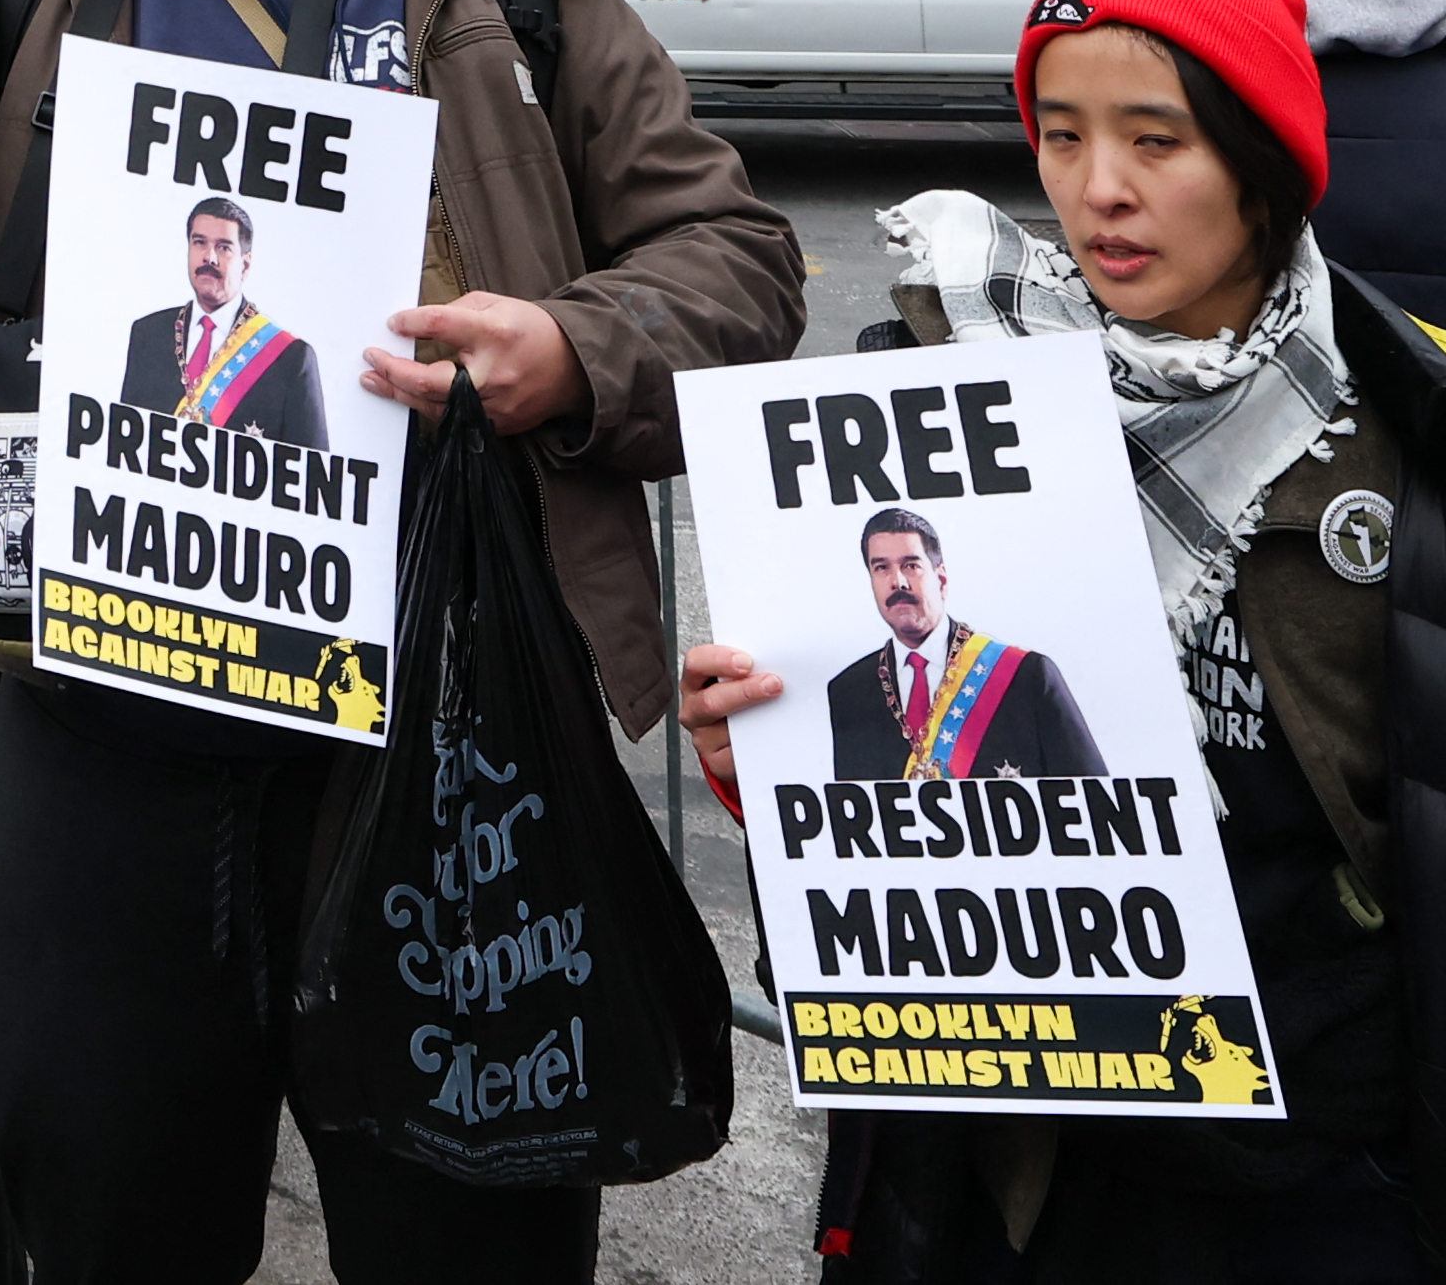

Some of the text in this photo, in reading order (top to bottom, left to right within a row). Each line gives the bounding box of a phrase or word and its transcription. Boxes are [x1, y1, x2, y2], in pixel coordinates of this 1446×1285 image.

[126, 81, 353, 214] FREE
[66, 392, 379, 526] PRESIDENT
[762, 380, 1031, 510] FREE
[72, 486, 352, 623] MADURO
[1331, 538, 1370, 574] AGAINST WAR
[43, 579, 257, 658] BROOKLYN
[43, 616, 322, 713] AGAINST WAR
[774, 777, 1184, 860] PRESIDENT
[805, 887, 1187, 980] MADURO
[793, 1002, 1075, 1041] BROOKLYN
[803, 1048, 1175, 1092] AGAINST WAR
